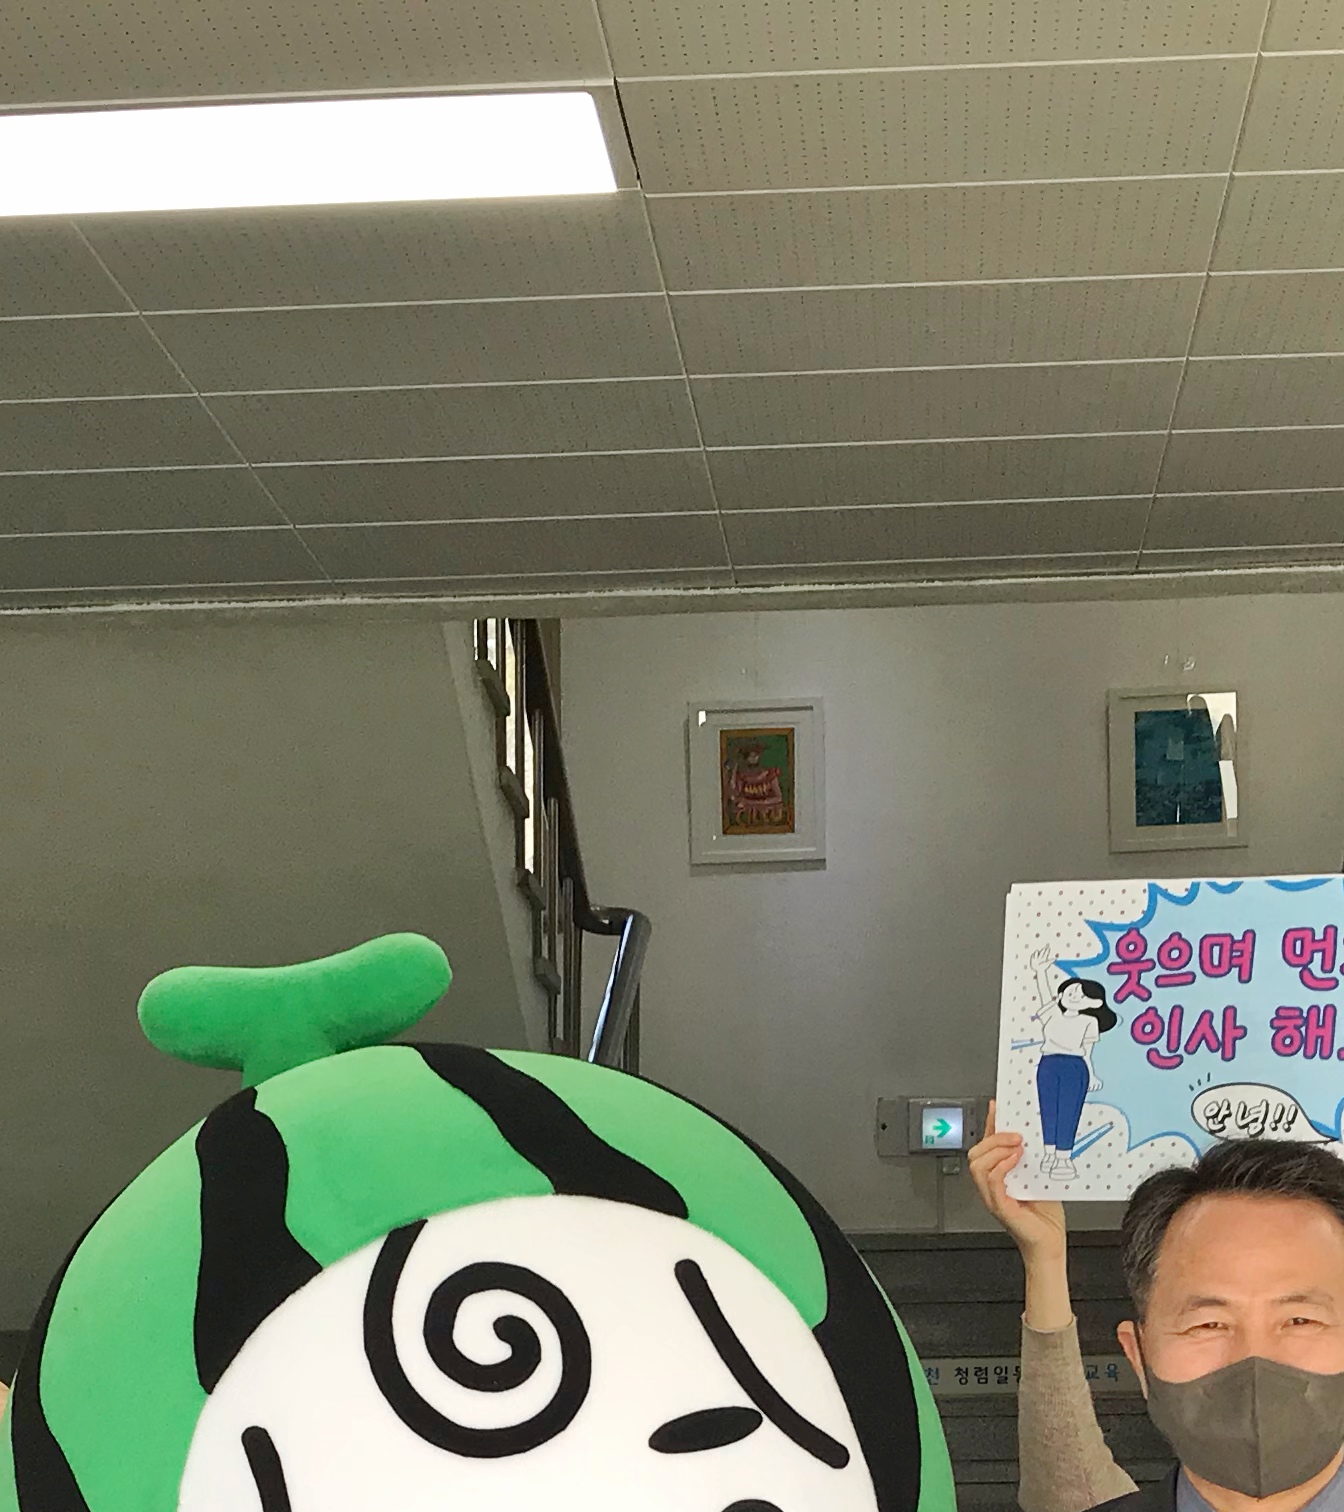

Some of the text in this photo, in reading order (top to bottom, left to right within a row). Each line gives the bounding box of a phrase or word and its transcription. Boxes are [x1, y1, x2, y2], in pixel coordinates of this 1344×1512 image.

[1107, 927, 1256, 1004] 웃으며
[1131, 1004, 1248, 1070] 인사
[1203, 1098, 1299, 1138] 안녕!!
